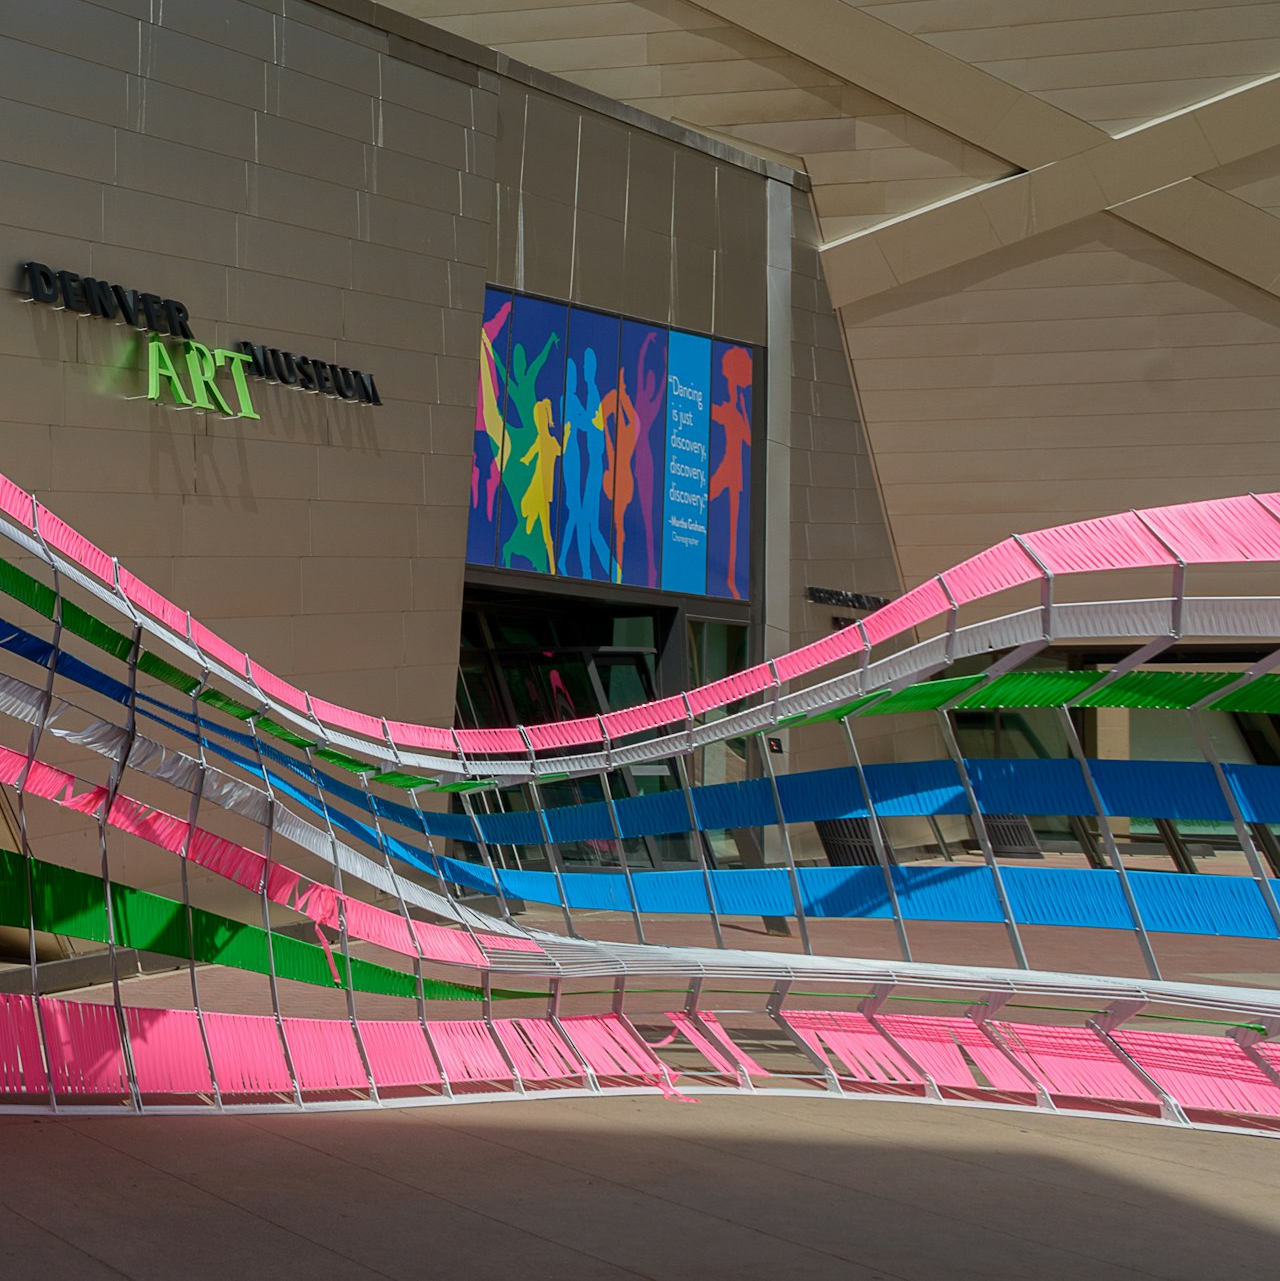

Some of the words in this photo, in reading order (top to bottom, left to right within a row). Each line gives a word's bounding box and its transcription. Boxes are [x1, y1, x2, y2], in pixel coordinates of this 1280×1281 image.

[24, 261, 195, 340] DENVER
[147, 333, 261, 420] ART
[239, 341, 383, 406] MUSEUM
[671, 402, 679, 422] is
[678, 405, 694, 430] just
[671, 429, 706, 462] discovery,
[670, 455, 705, 488] discovery,
